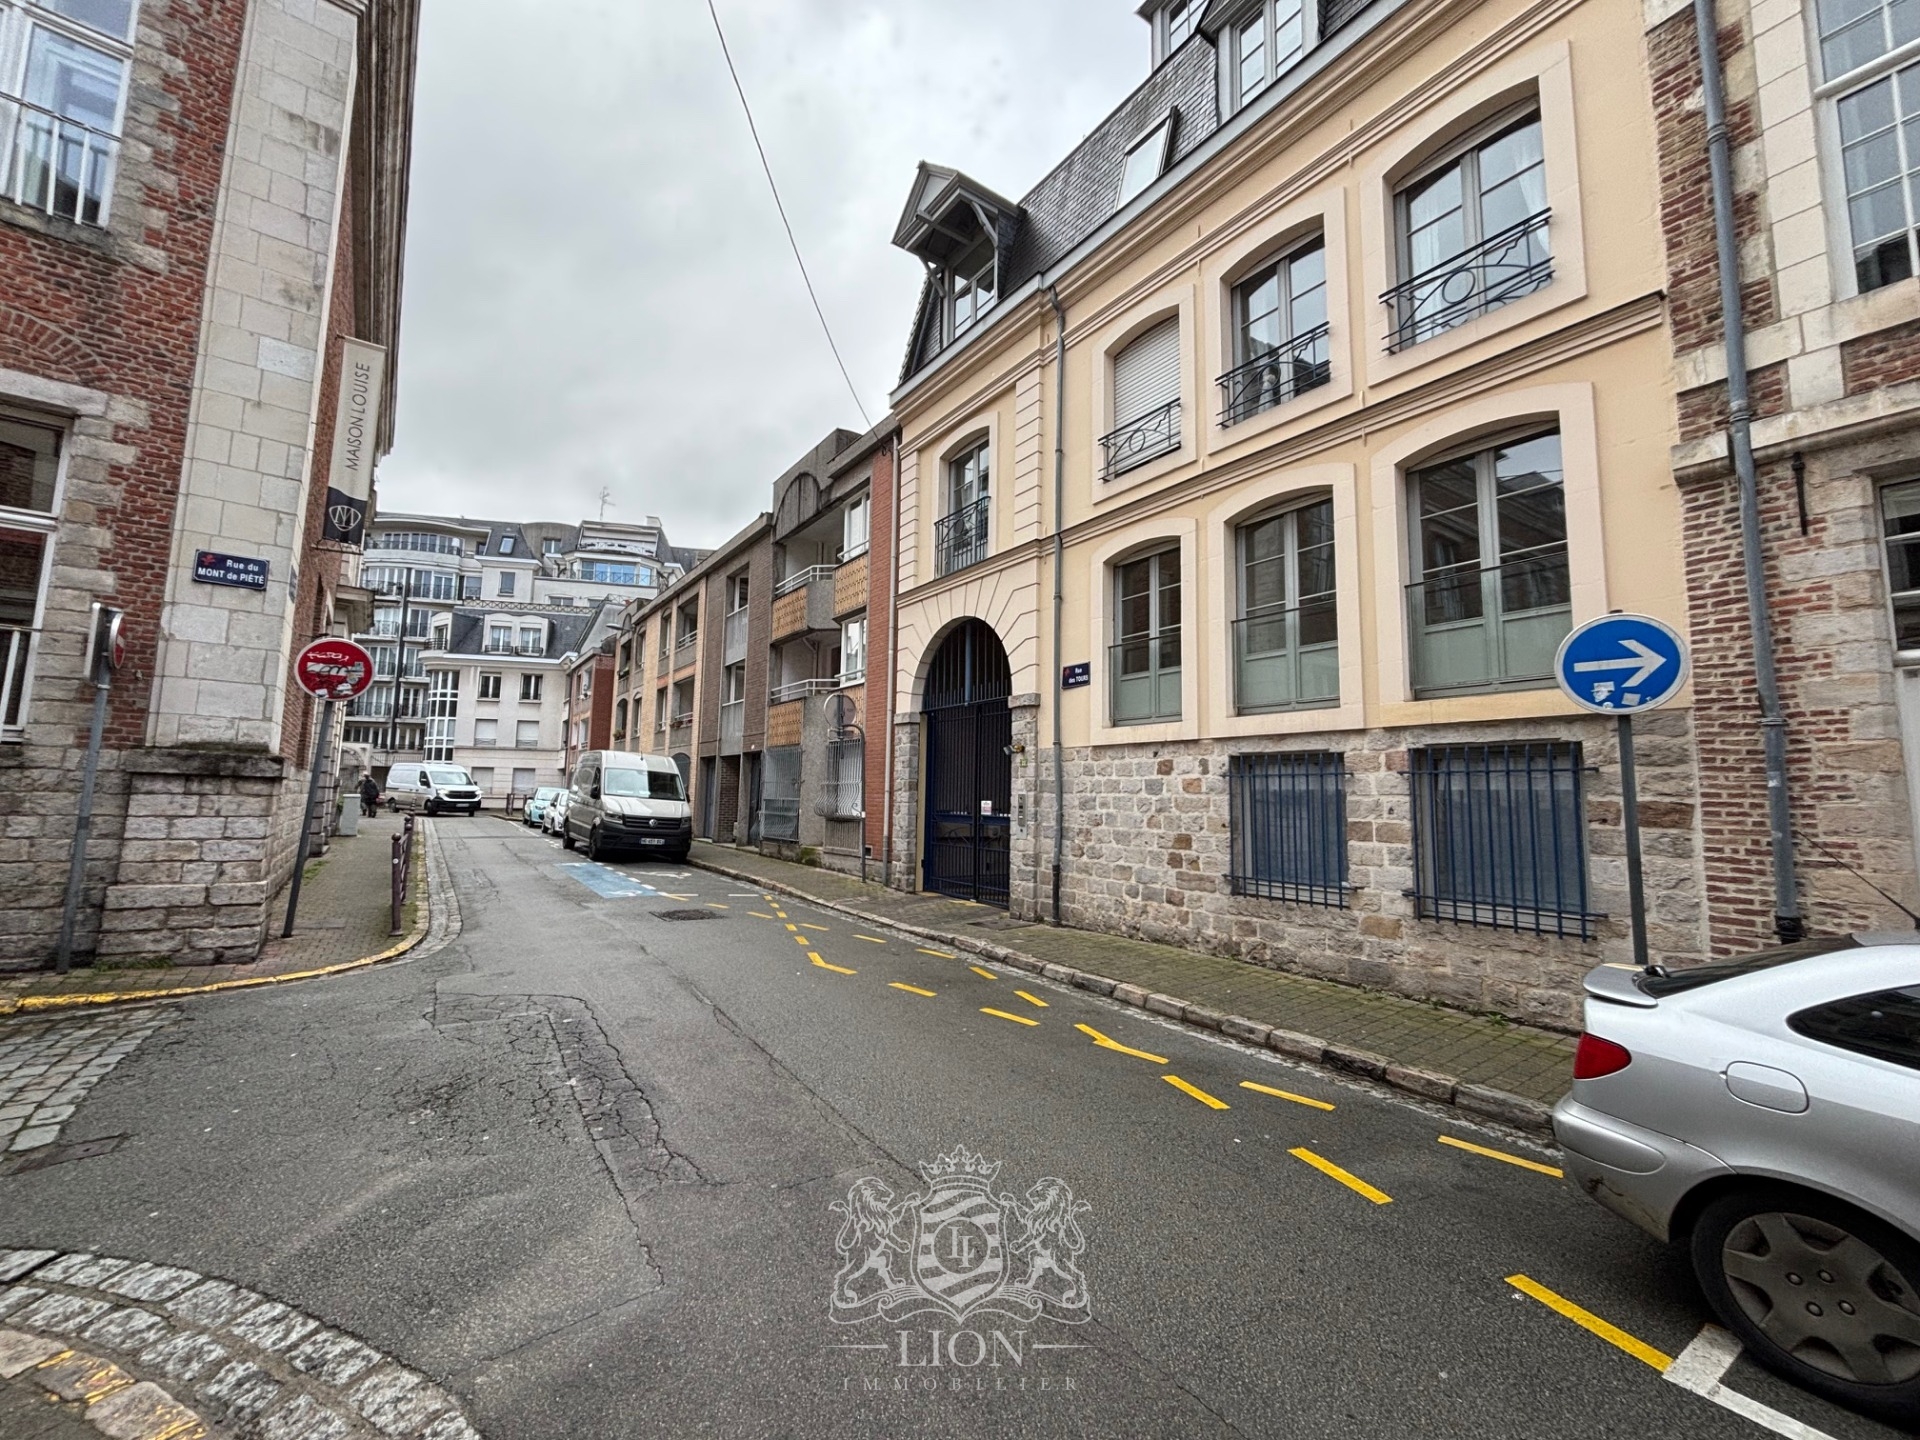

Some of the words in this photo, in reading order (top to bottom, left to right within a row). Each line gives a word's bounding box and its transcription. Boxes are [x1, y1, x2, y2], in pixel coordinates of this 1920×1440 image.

[352, 362, 370, 414] LOUISE
[345, 416, 363, 471] MAISON
[197, 567, 225, 578] MONT
[226, 572, 238, 580] de
[226, 559, 244, 569] Rue
[247, 563, 259, 572] du
